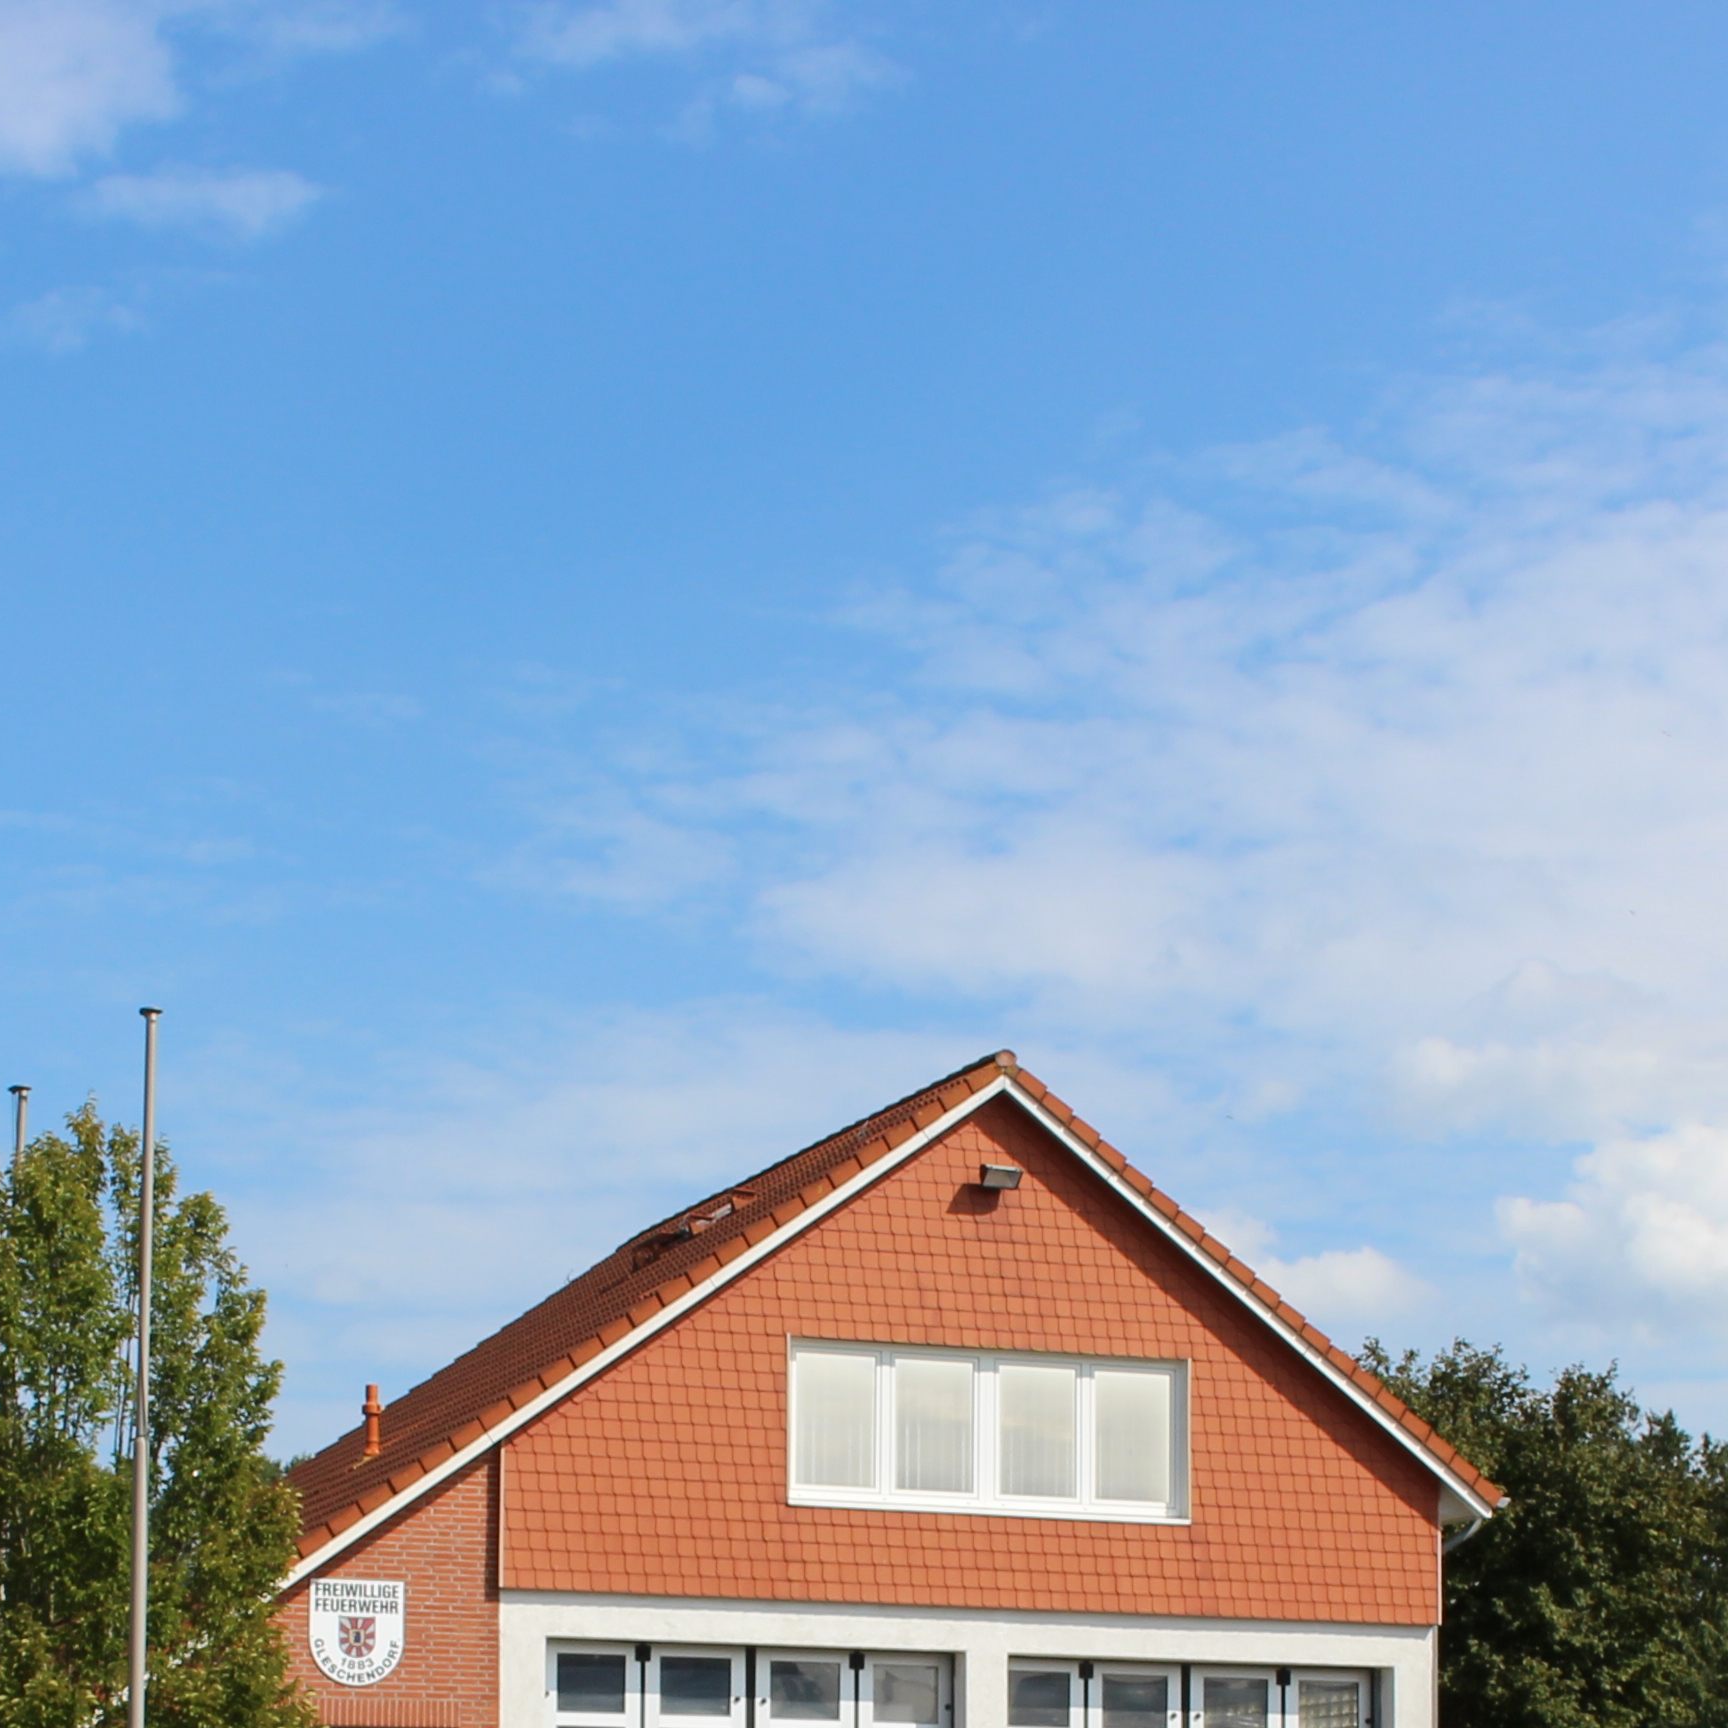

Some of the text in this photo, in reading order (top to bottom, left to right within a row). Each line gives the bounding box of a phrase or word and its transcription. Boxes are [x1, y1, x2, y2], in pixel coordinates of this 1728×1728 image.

[314, 1582, 399, 1599] FREIWILLIGE
[314, 1598, 399, 1614] FEUERWEHR
[314, 1638, 400, 1683] GLESCHENDORF
[341, 1657, 375, 1670] 1883
